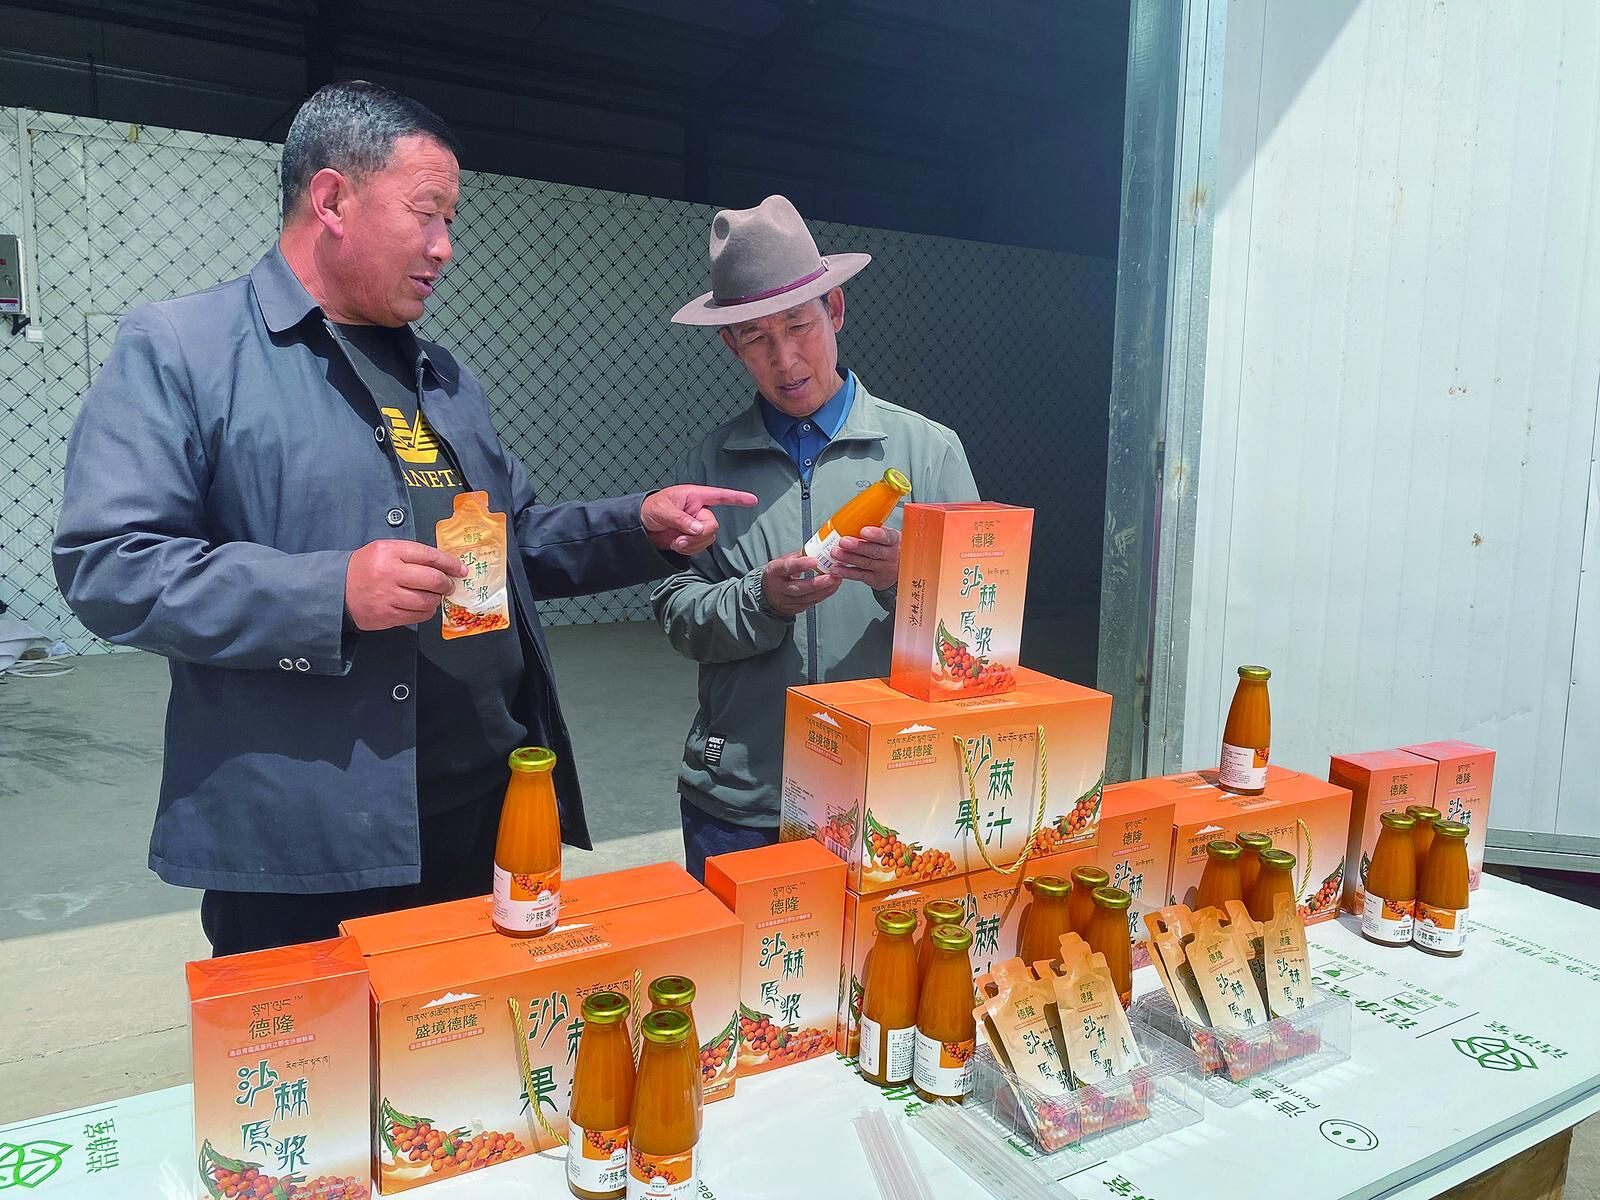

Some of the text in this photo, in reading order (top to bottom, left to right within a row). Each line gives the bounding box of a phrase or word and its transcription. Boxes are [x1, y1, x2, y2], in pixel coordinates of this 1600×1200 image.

[972, 533, 995, 548] 德隆
[807, 729, 839, 754] 盛境德隆
[891, 744, 934, 761] 盛境德隆
[1390, 784, 1409, 796] 德隆
[954, 799, 1013, 849] 果汁
[1123, 830, 1142, 846] 德隆
[771, 896, 799, 916] 德隆
[248, 1014, 295, 1040] 德隆
[415, 1013, 478, 1040] 盛境德隆
[236, 1059, 310, 1122] 沙棘
[82, 1117, 120, 1174] 洁净室
[241, 1119, 311, 1173] 原浆
